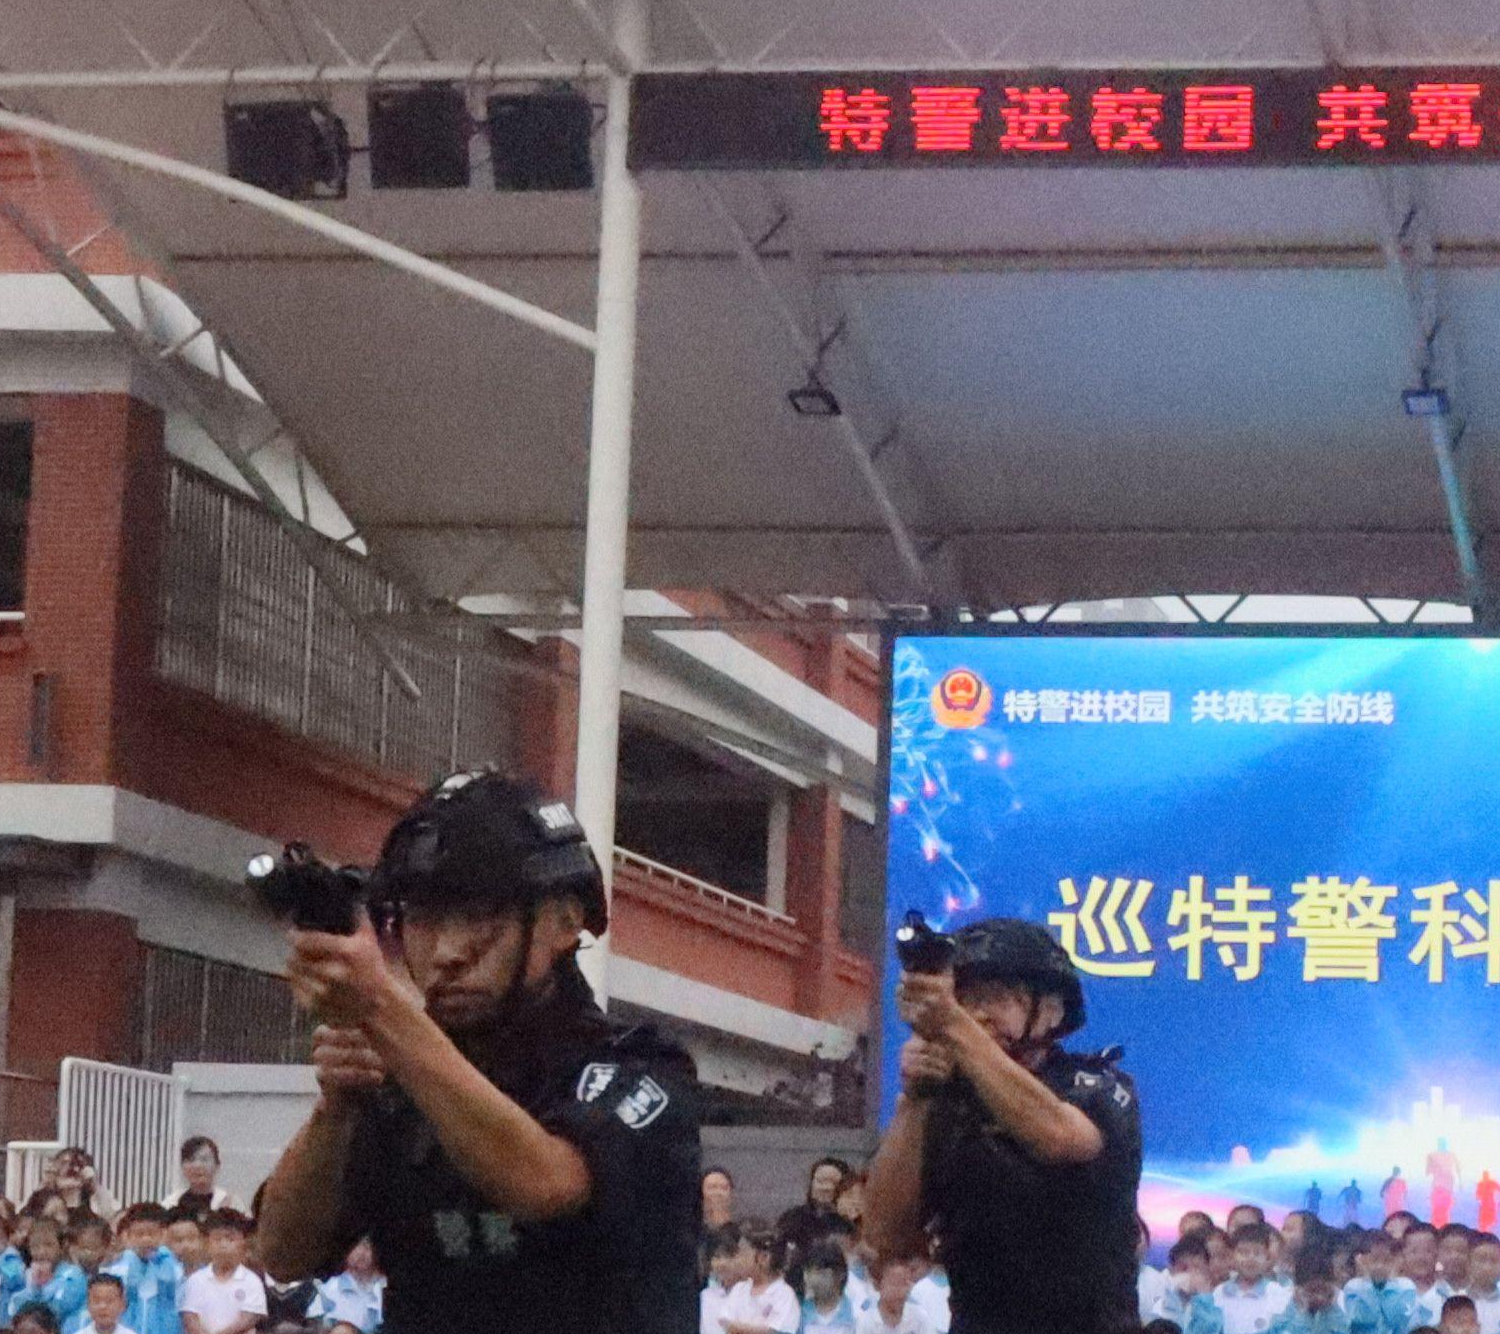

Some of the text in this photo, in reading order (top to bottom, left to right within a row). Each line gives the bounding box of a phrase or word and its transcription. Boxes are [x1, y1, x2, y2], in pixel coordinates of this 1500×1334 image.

[819, 84, 1255, 152] 特警进校园
[1001, 688, 1396, 726] 特警进校园 共筑安全防线
